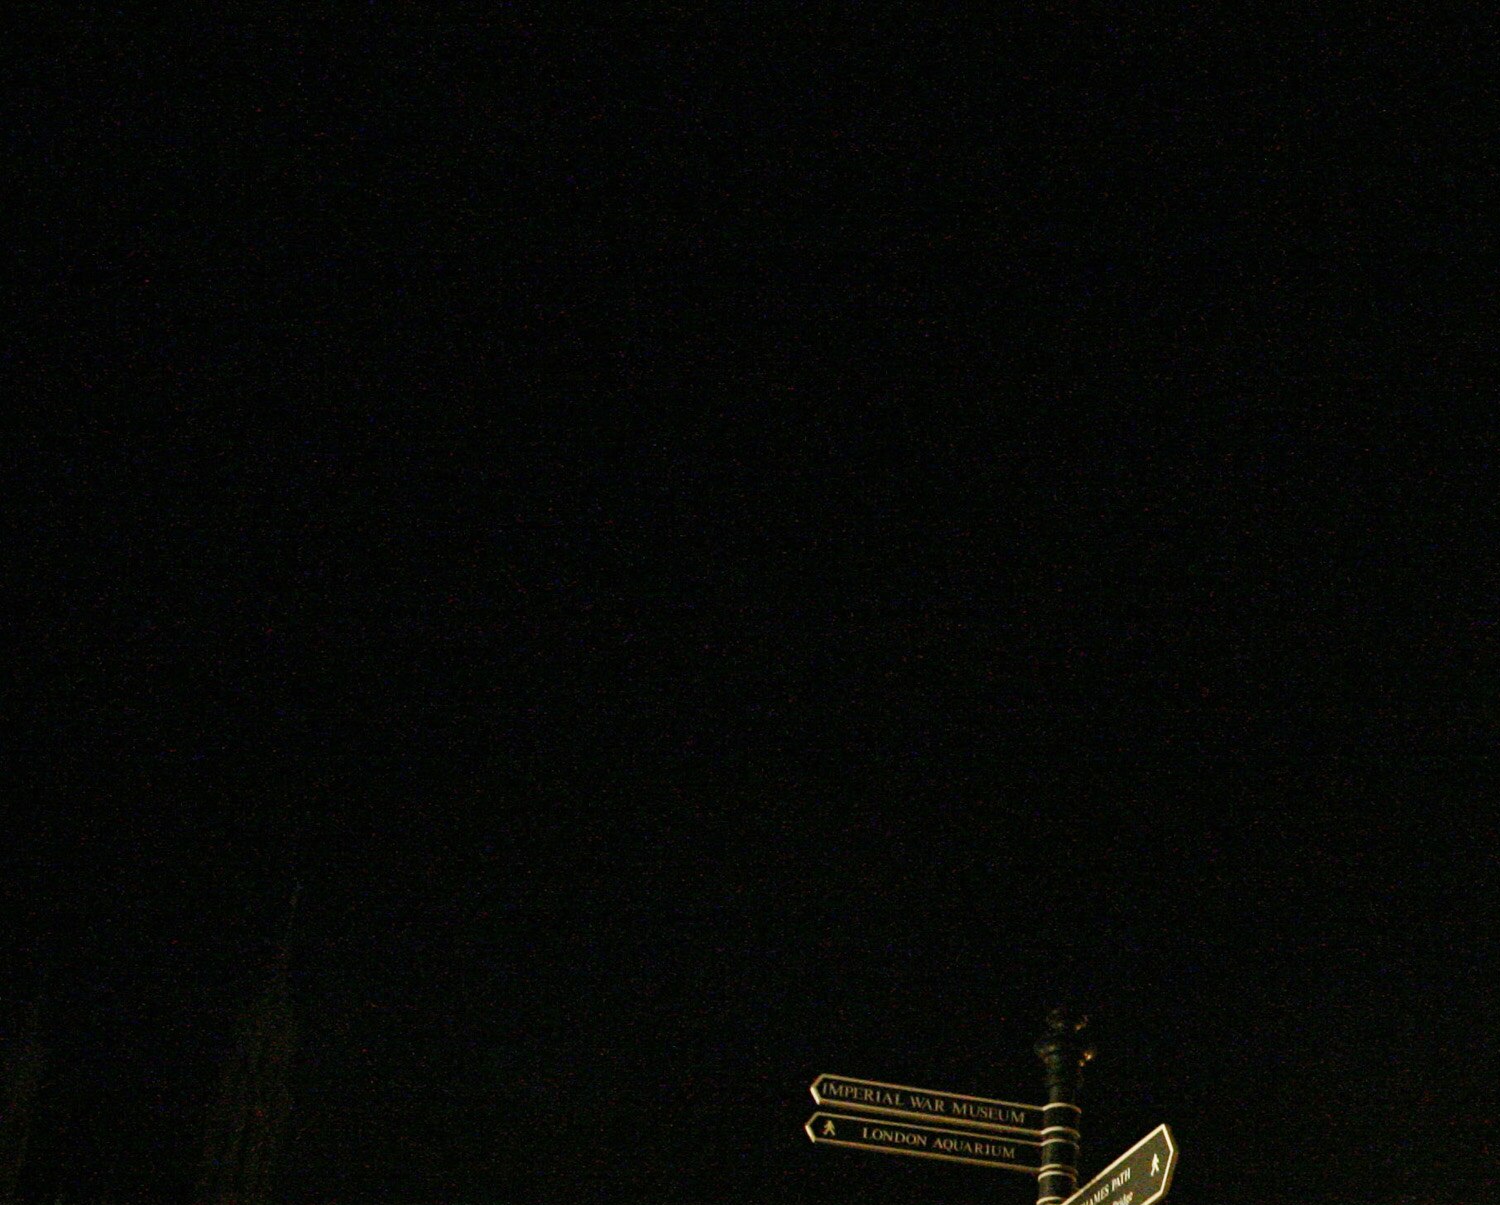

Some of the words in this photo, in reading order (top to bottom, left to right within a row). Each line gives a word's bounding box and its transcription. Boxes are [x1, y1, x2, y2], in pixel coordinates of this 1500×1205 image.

[822, 1082, 904, 1107] IMPERIAL
[909, 1096, 946, 1112] WAR
[952, 1102, 1026, 1125] MUSEUM
[862, 1126, 928, 1147] LONDON
[933, 1137, 1016, 1159] AQUARIUM
[1111, 1167, 1131, 1192] PATH
